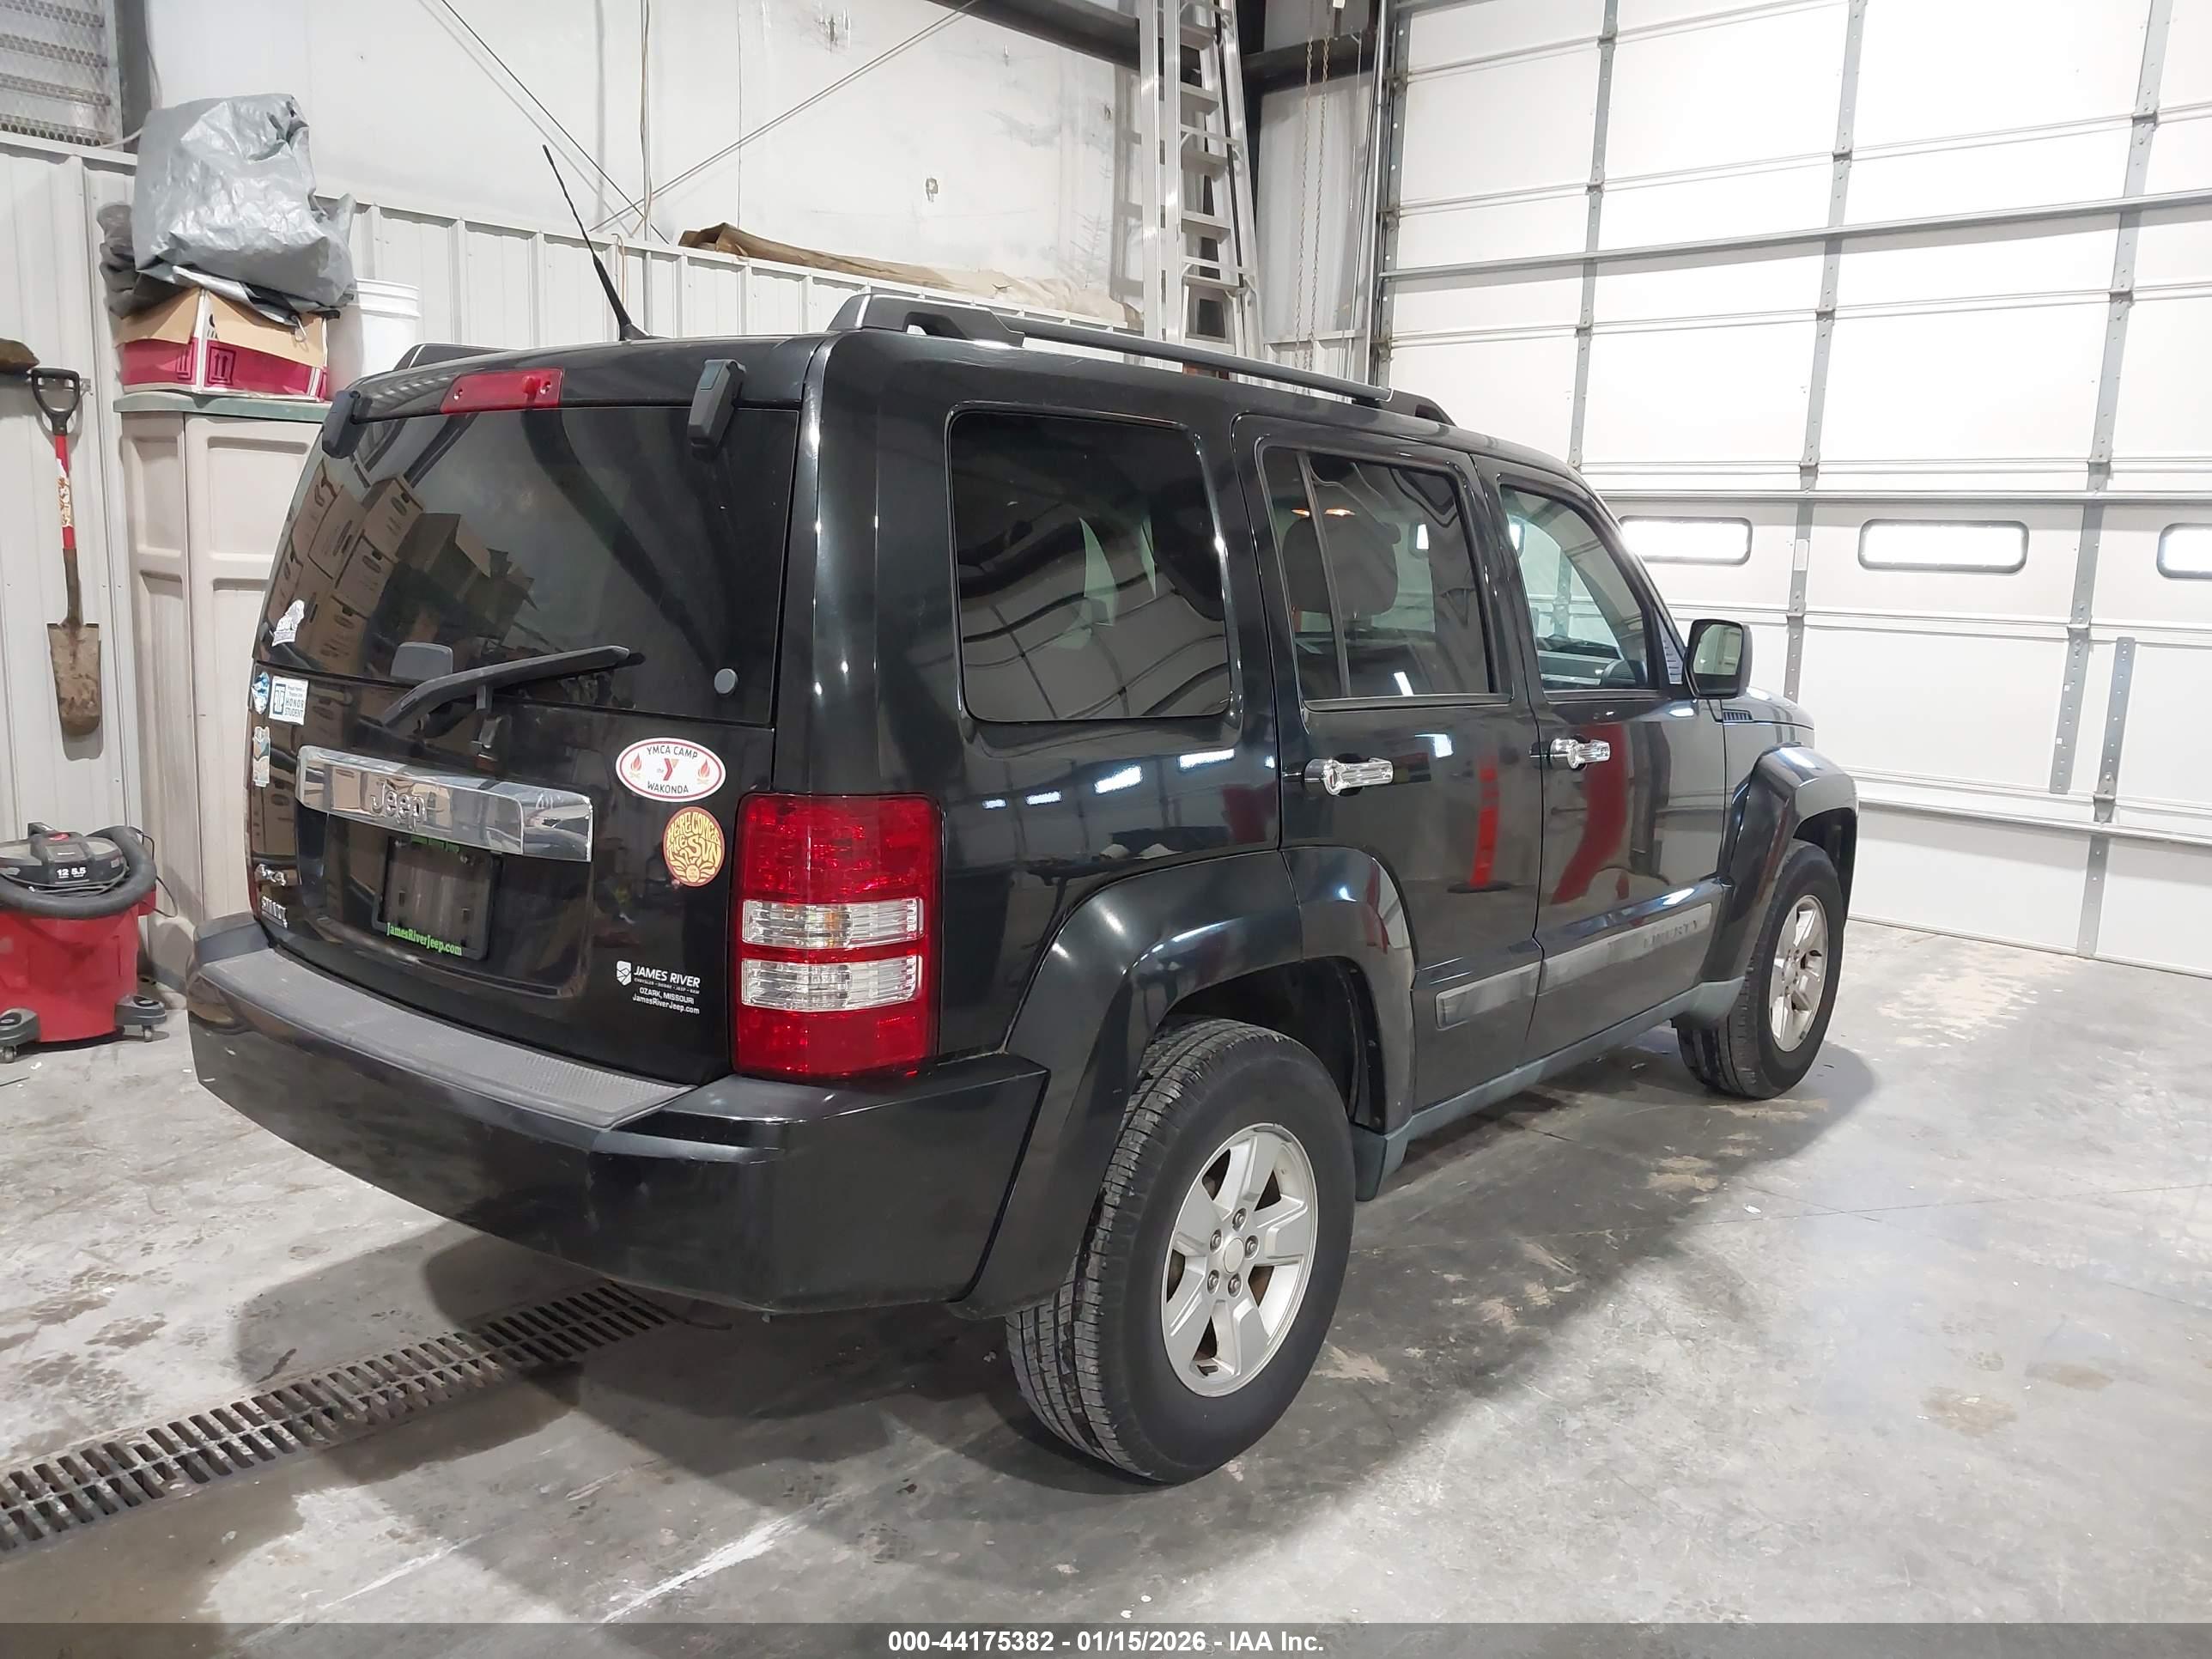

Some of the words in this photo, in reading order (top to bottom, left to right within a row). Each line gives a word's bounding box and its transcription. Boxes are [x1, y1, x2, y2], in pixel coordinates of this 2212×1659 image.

[647, 744, 670, 755] YMCA
[673, 746, 698, 760] CAMP
[647, 781, 689, 794] WAKONDA
[370, 780, 428, 832] Jeep
[666, 811, 694, 848] HERE
[684, 835, 721, 868] SUN
[71, 866, 86, 875] 5.5
[386, 922, 462, 956] JamesRiverJeep.com
[634, 966, 668, 981] JAMES
[670, 972, 701, 988] RIVER
[632, 993, 700, 1014] JamesRiverJeep.com
[639, 987, 662, 1000] OZARK,
[663, 992, 695, 1005] MISSOURI
